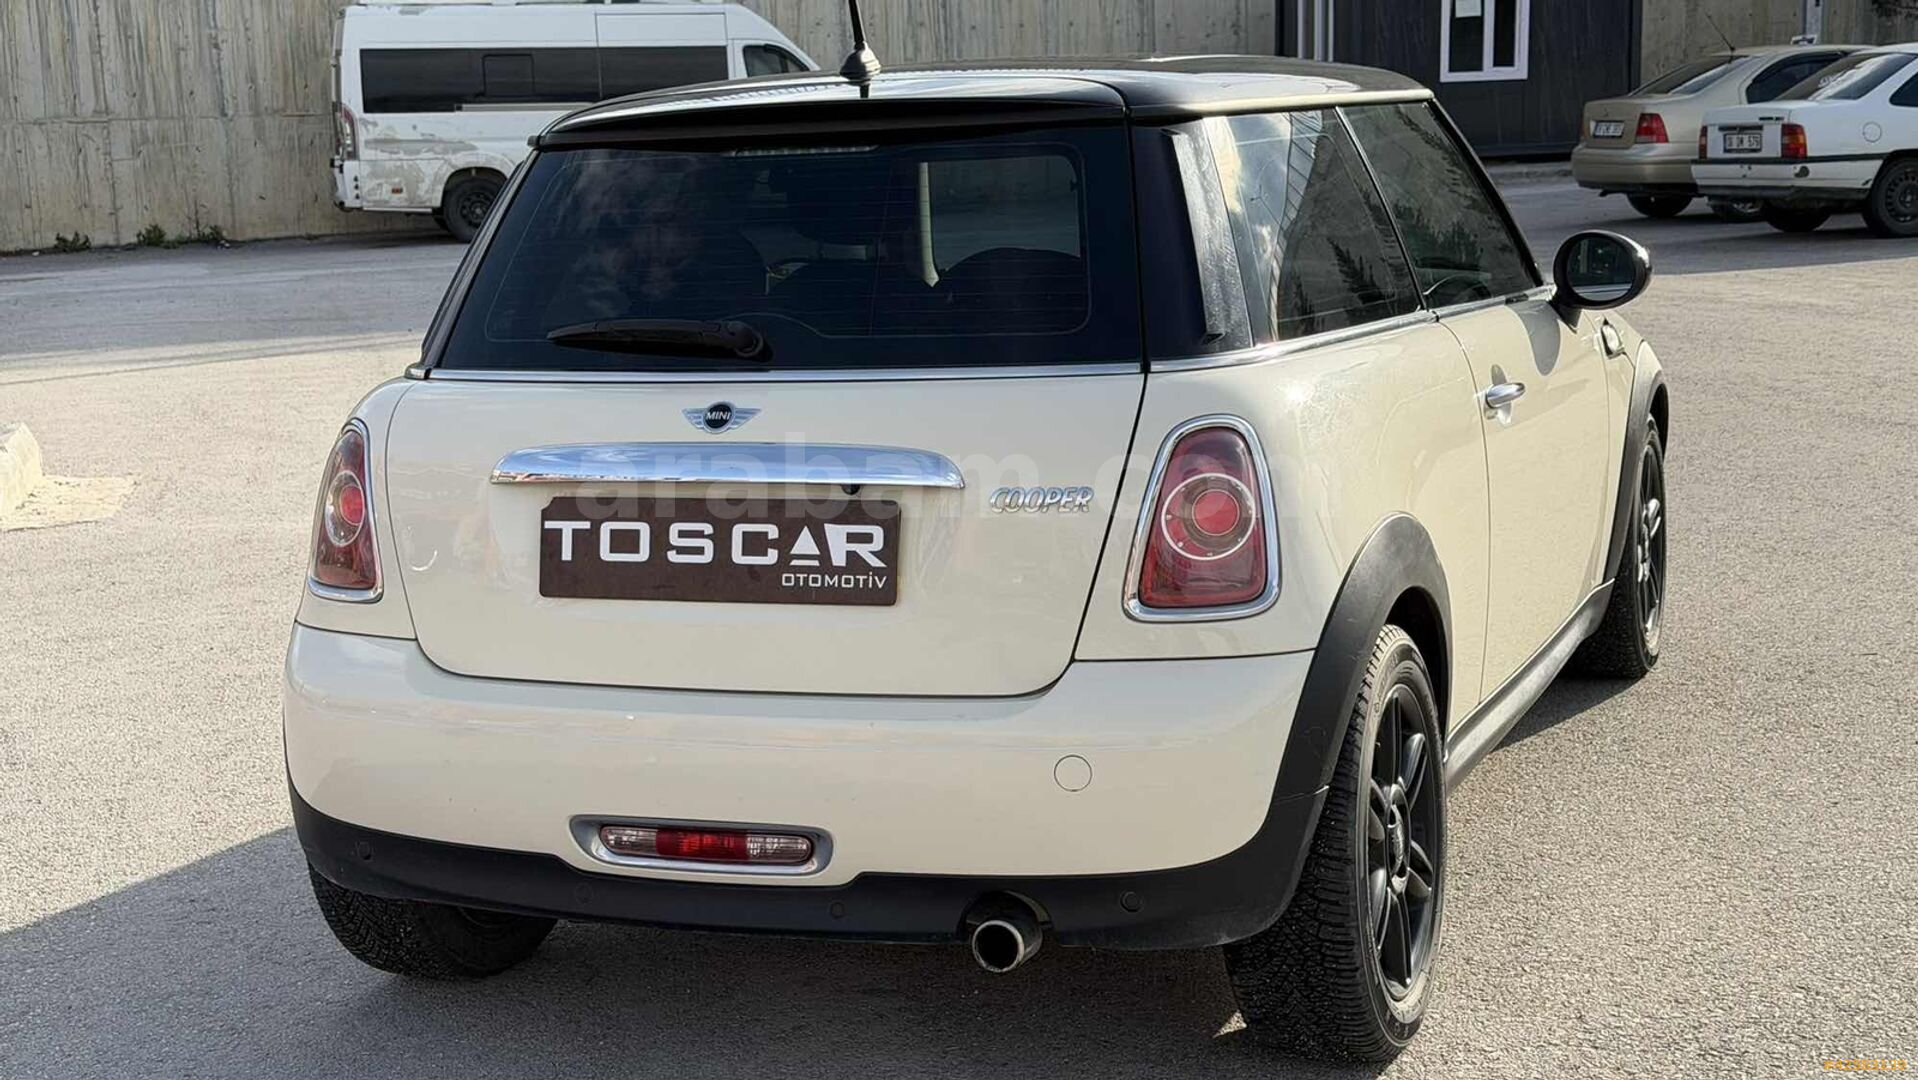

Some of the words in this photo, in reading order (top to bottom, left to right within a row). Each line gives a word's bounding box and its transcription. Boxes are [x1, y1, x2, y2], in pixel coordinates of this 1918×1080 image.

[705, 411, 731, 421] MINI
[989, 486, 1094, 514] COOPER
[543, 520, 887, 568] TOSCAR
[781, 571, 887, 590] OTOMOTİV
